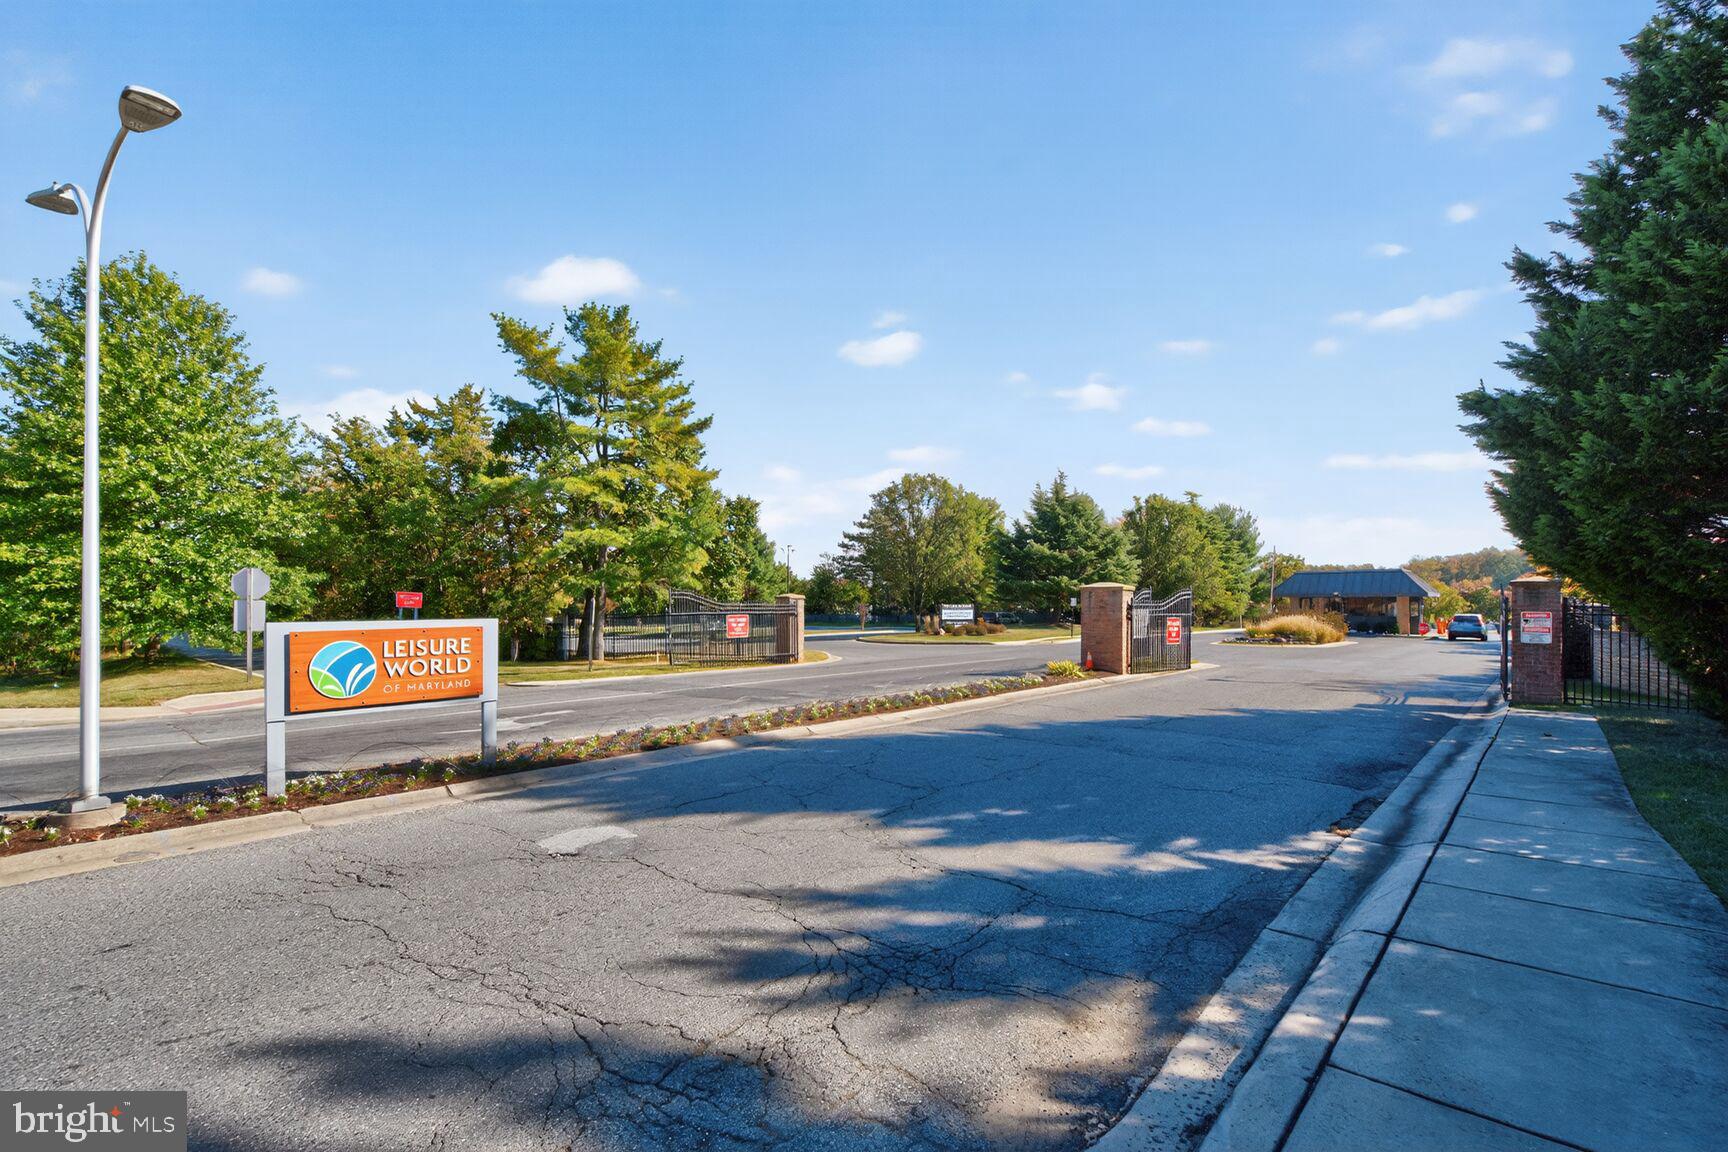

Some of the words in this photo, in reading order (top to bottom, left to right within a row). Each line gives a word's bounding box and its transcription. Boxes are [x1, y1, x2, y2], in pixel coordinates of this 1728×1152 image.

[383, 637, 472, 659] LEISURE
[383, 657, 472, 679] WORLD
[383, 683, 401, 694] OF
[407, 678, 471, 692] MARYLAND
